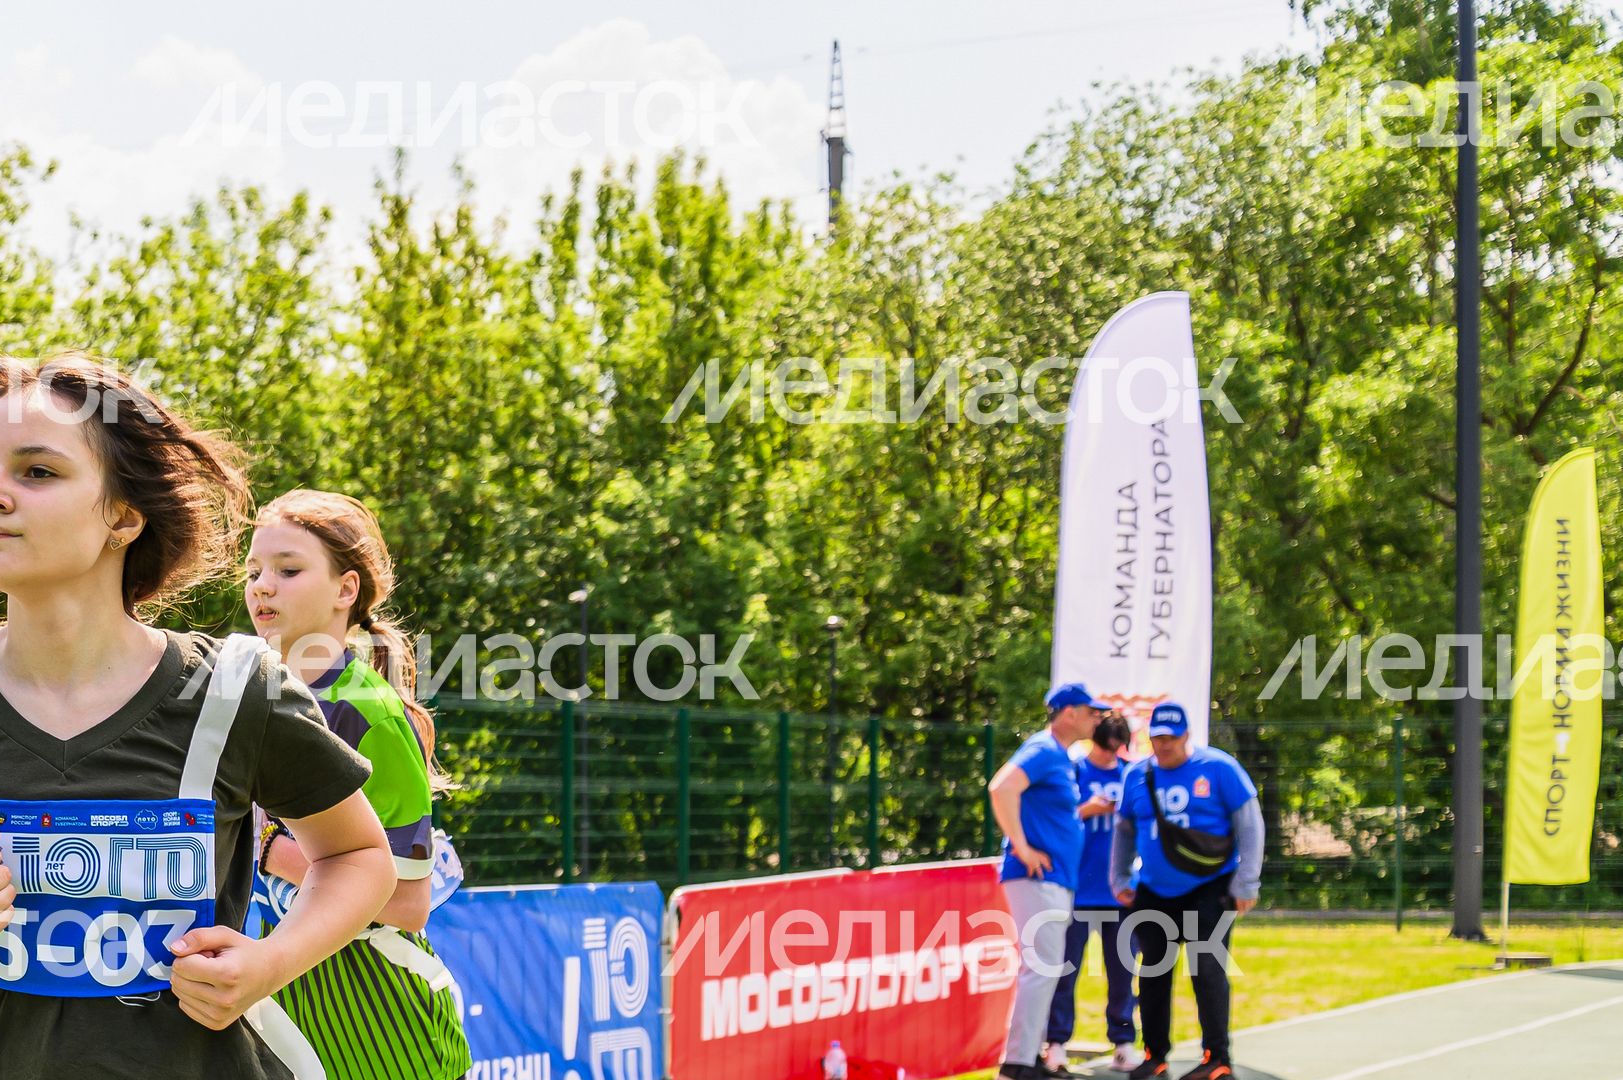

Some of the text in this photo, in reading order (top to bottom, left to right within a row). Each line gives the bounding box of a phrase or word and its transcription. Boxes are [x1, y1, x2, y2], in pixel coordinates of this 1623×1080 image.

[1109, 480, 1139, 659] КОМАНДА
[1147, 417, 1175, 660] ГУБЕРНАТОРА
[1543, 517, 1574, 837] СПОРТ НОРМА ЖИЗНИ
